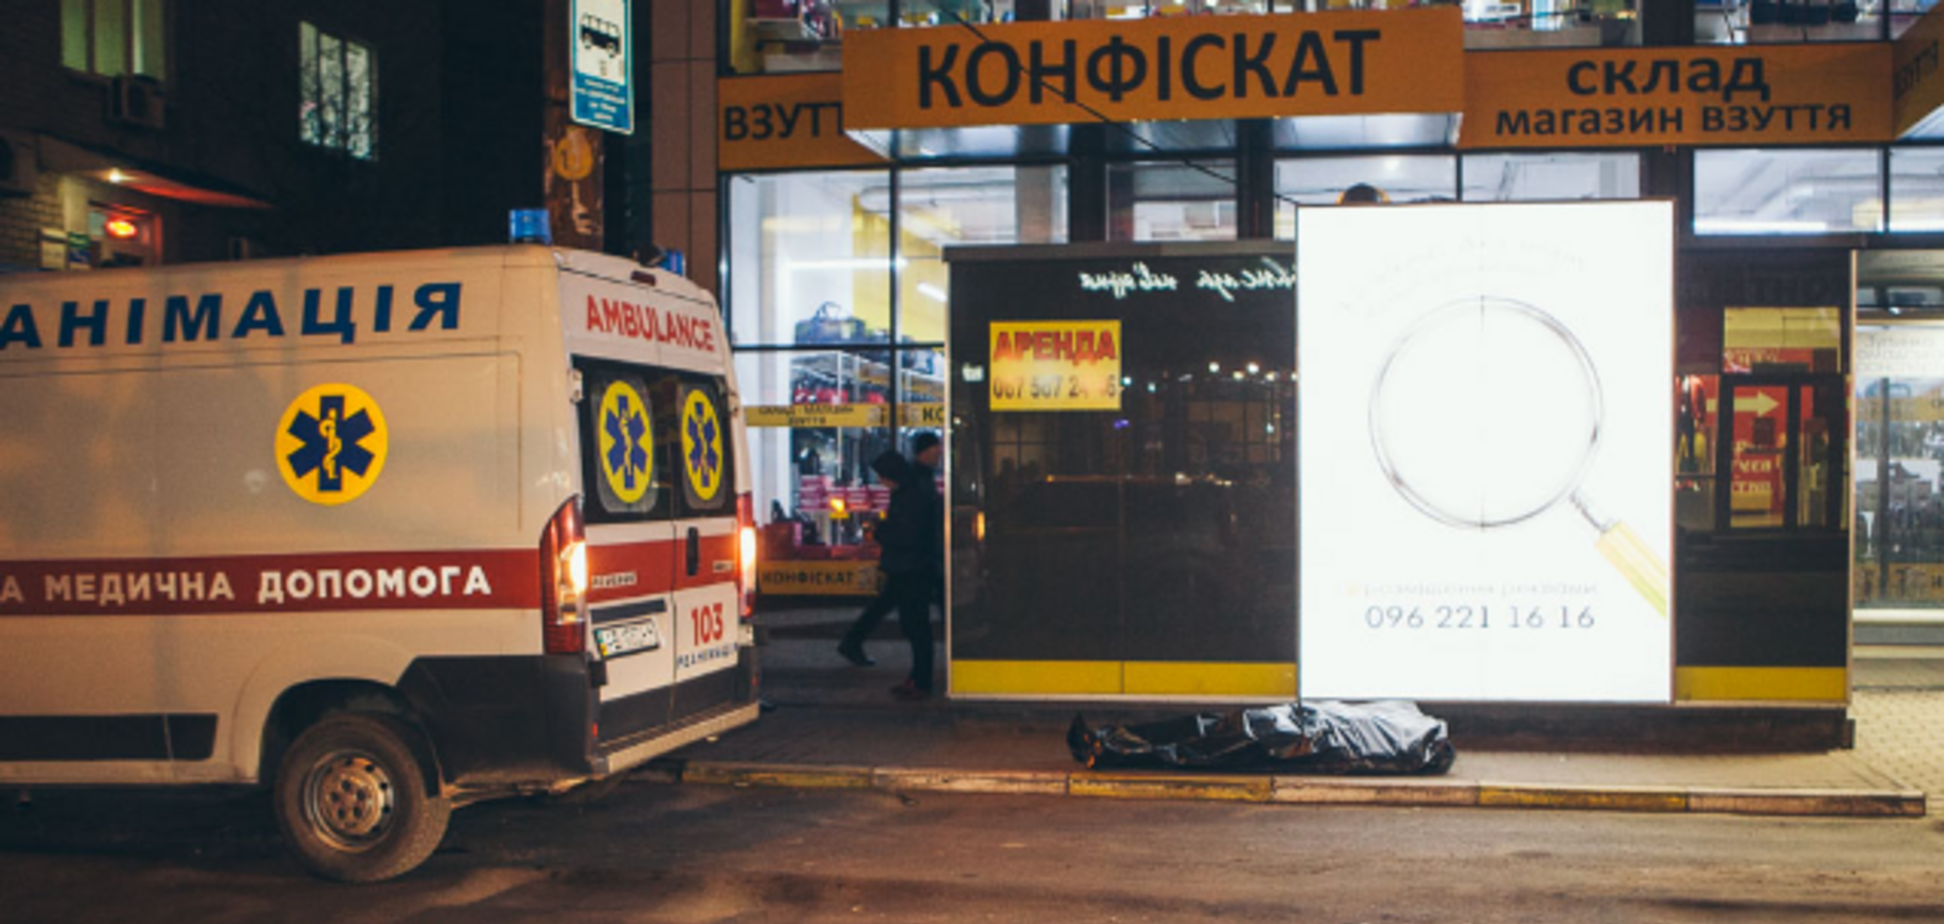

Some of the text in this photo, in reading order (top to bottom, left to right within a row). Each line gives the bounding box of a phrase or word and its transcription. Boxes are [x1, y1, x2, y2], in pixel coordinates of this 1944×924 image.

[917, 29, 1382, 110] КОНФІСКАТ
[1566, 55, 1773, 101] склад
[1495, 103, 1853, 136] магазин ВЗУТТЯ
[0, 282, 462, 349] АНІМАЦІЯ
[586, 294, 714, 352] AMBULANCE
[993, 330, 1117, 367] АРЕНДА
[44, 571, 235, 607] МЕДИЧНА
[257, 565, 493, 605] ДОПОМОГА
[761, 569, 855, 587] КОНФІСКАТ
[690, 601, 725, 647] 103
[1365, 604, 1596, 630] 096 221 16 16
